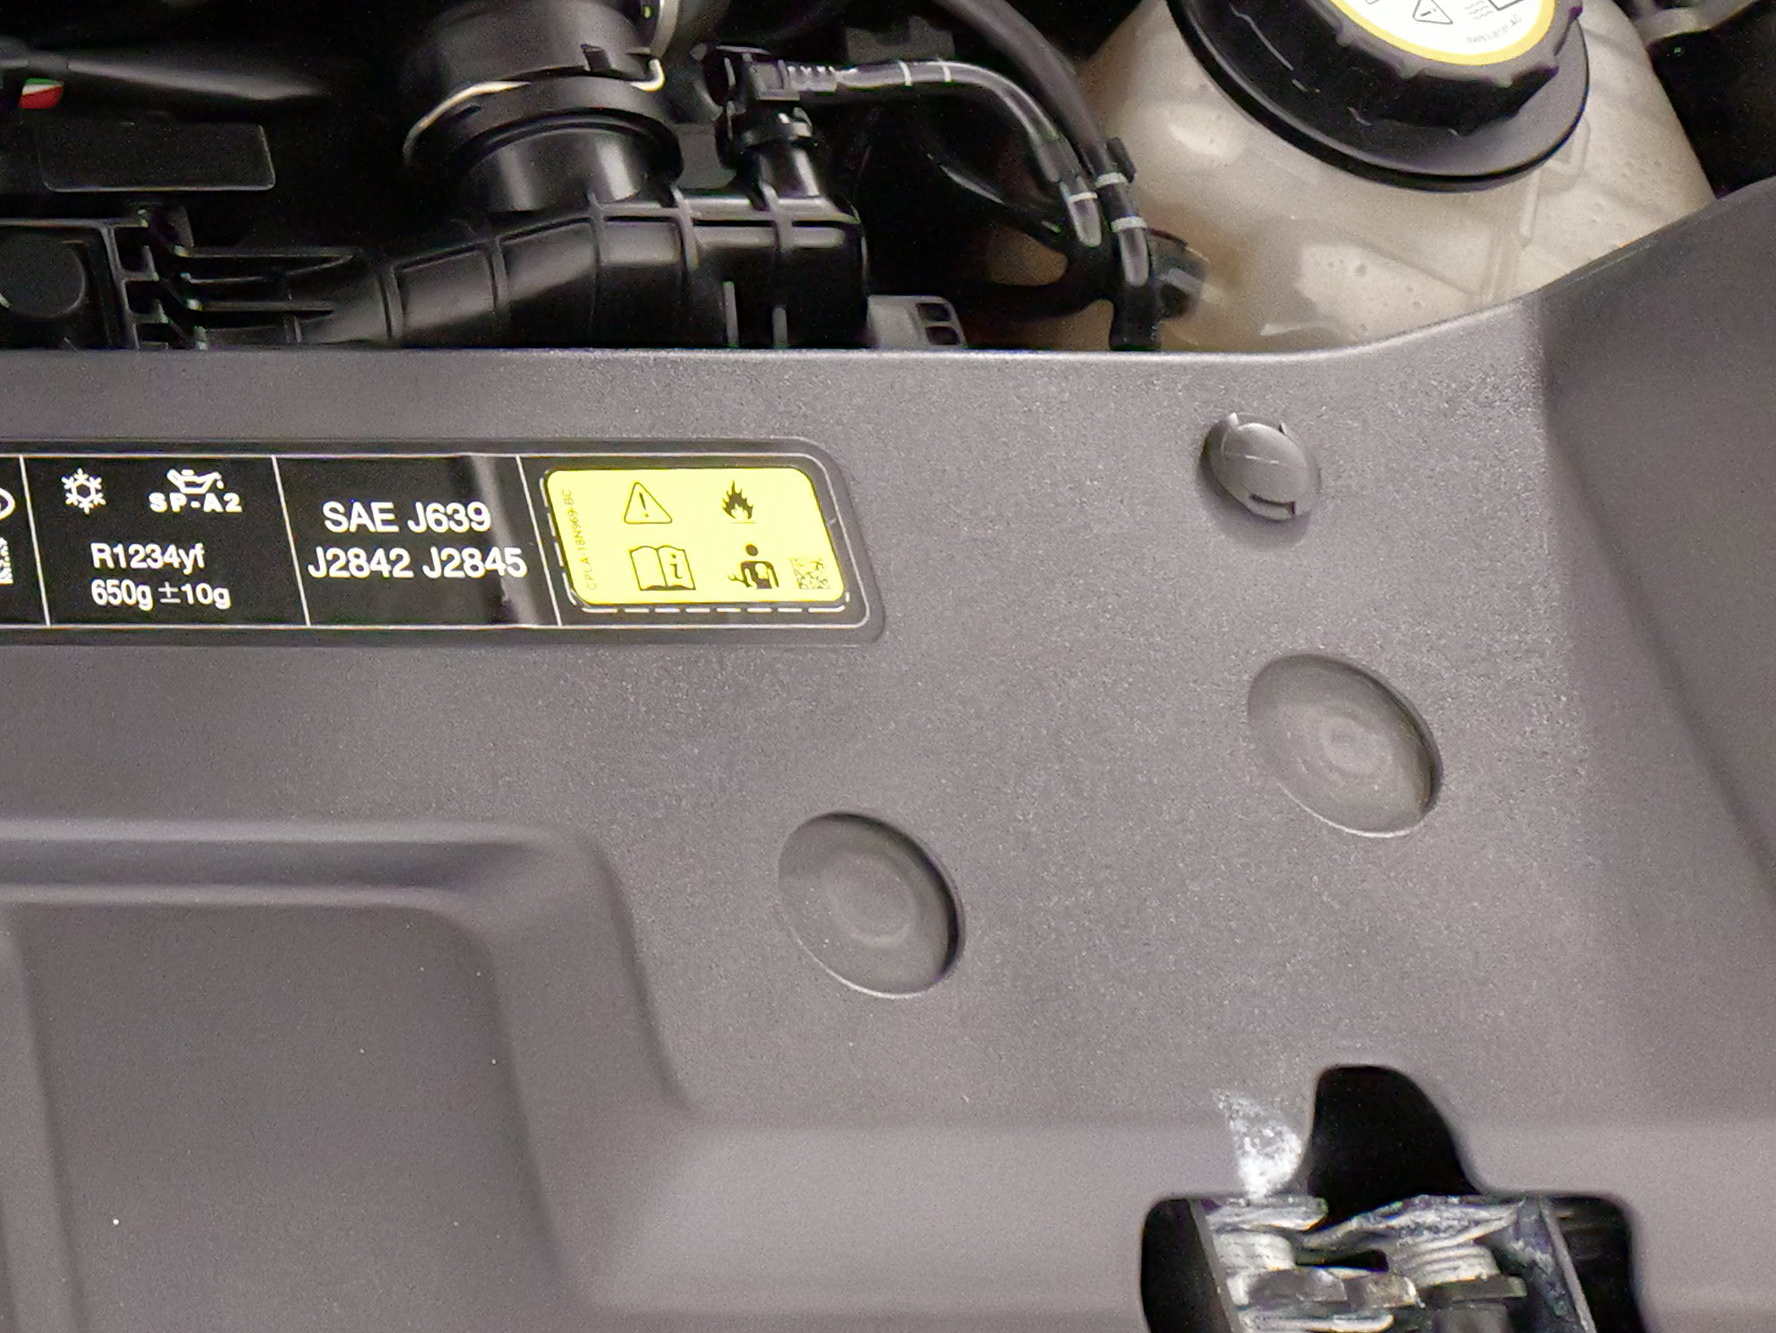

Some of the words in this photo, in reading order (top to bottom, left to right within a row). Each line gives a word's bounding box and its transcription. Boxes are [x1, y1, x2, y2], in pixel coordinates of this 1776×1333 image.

[148, 492, 243, 513] SP-A2
[322, 500, 400, 533] SAE
[407, 501, 492, 533] J639
[90, 542, 205, 575] R1234yf
[307, 546, 415, 578] J2842
[422, 546, 528, 578] J2845
[91, 579, 154, 611] 650g
[158, 582, 231, 610] ±10g
